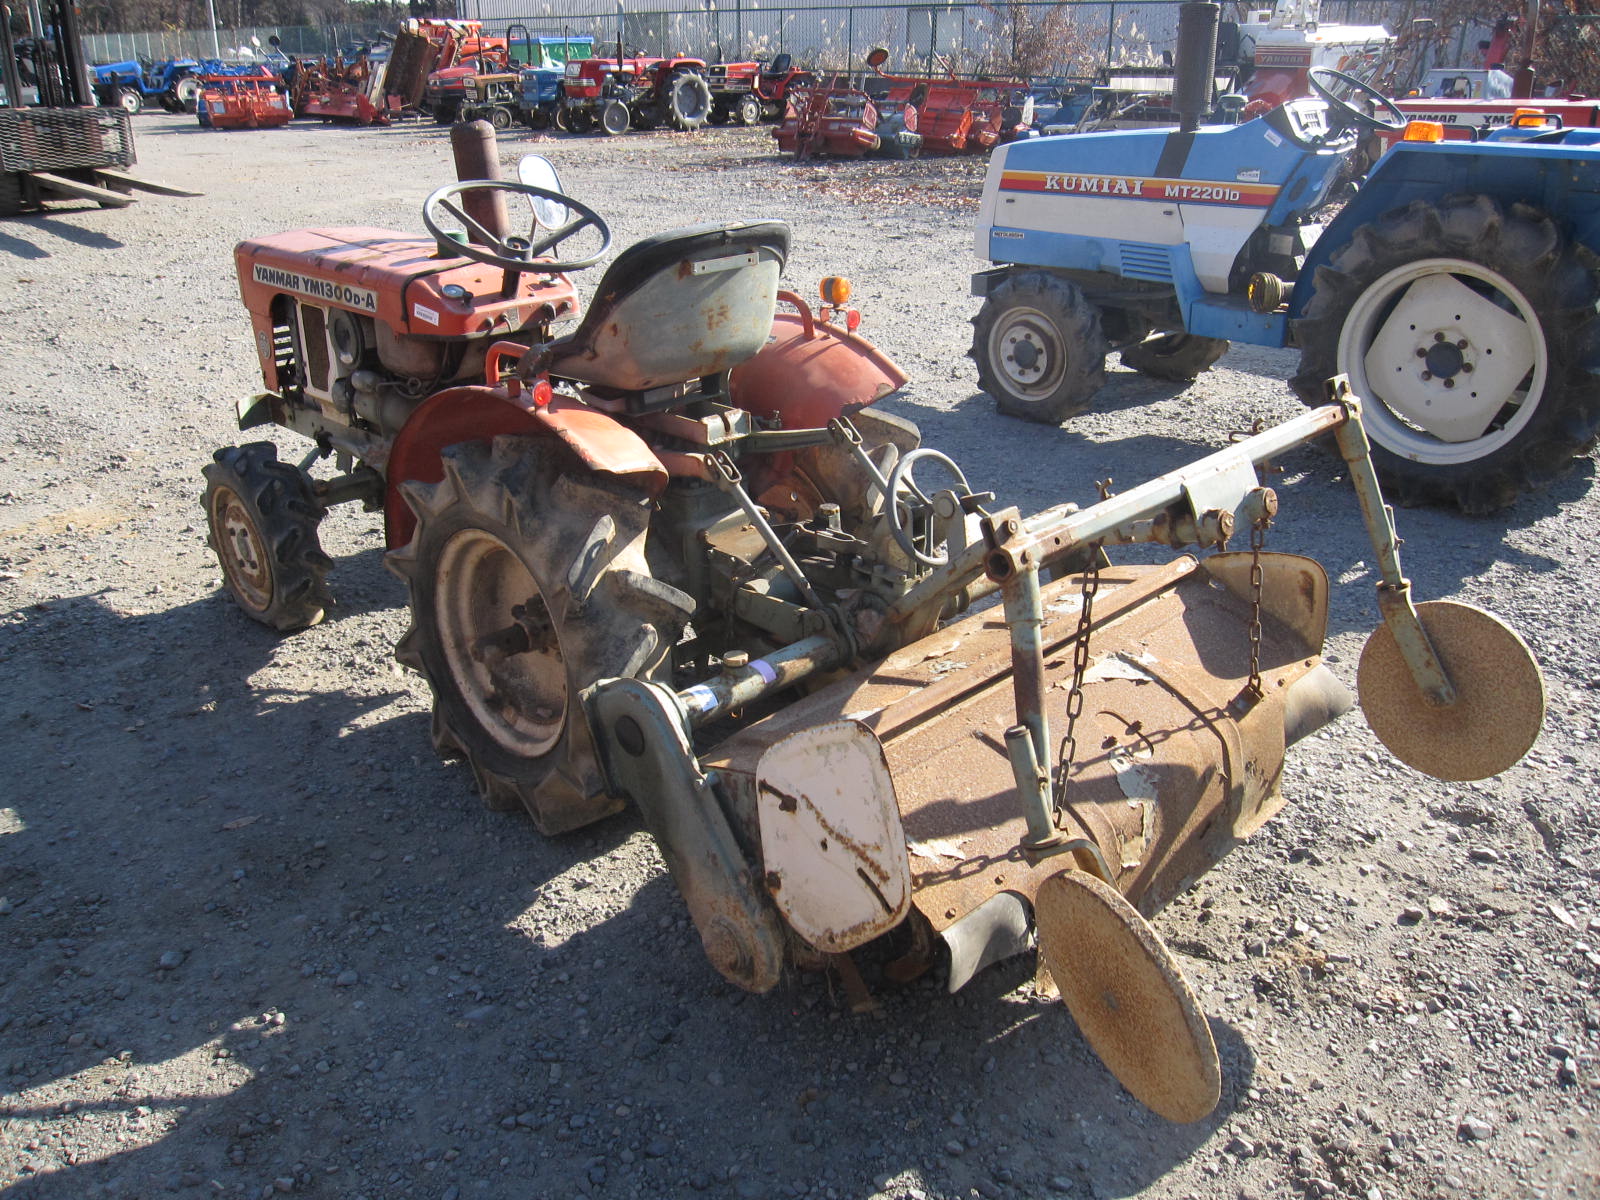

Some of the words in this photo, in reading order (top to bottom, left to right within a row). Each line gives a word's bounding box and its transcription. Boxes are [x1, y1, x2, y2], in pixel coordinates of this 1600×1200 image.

[1044, 175, 1144, 196] KUMIAI
[1164, 184, 1241, 201] MT2201D
[255, 266, 300, 290] YANMAR
[301, 277, 376, 310] YM1300D-A
